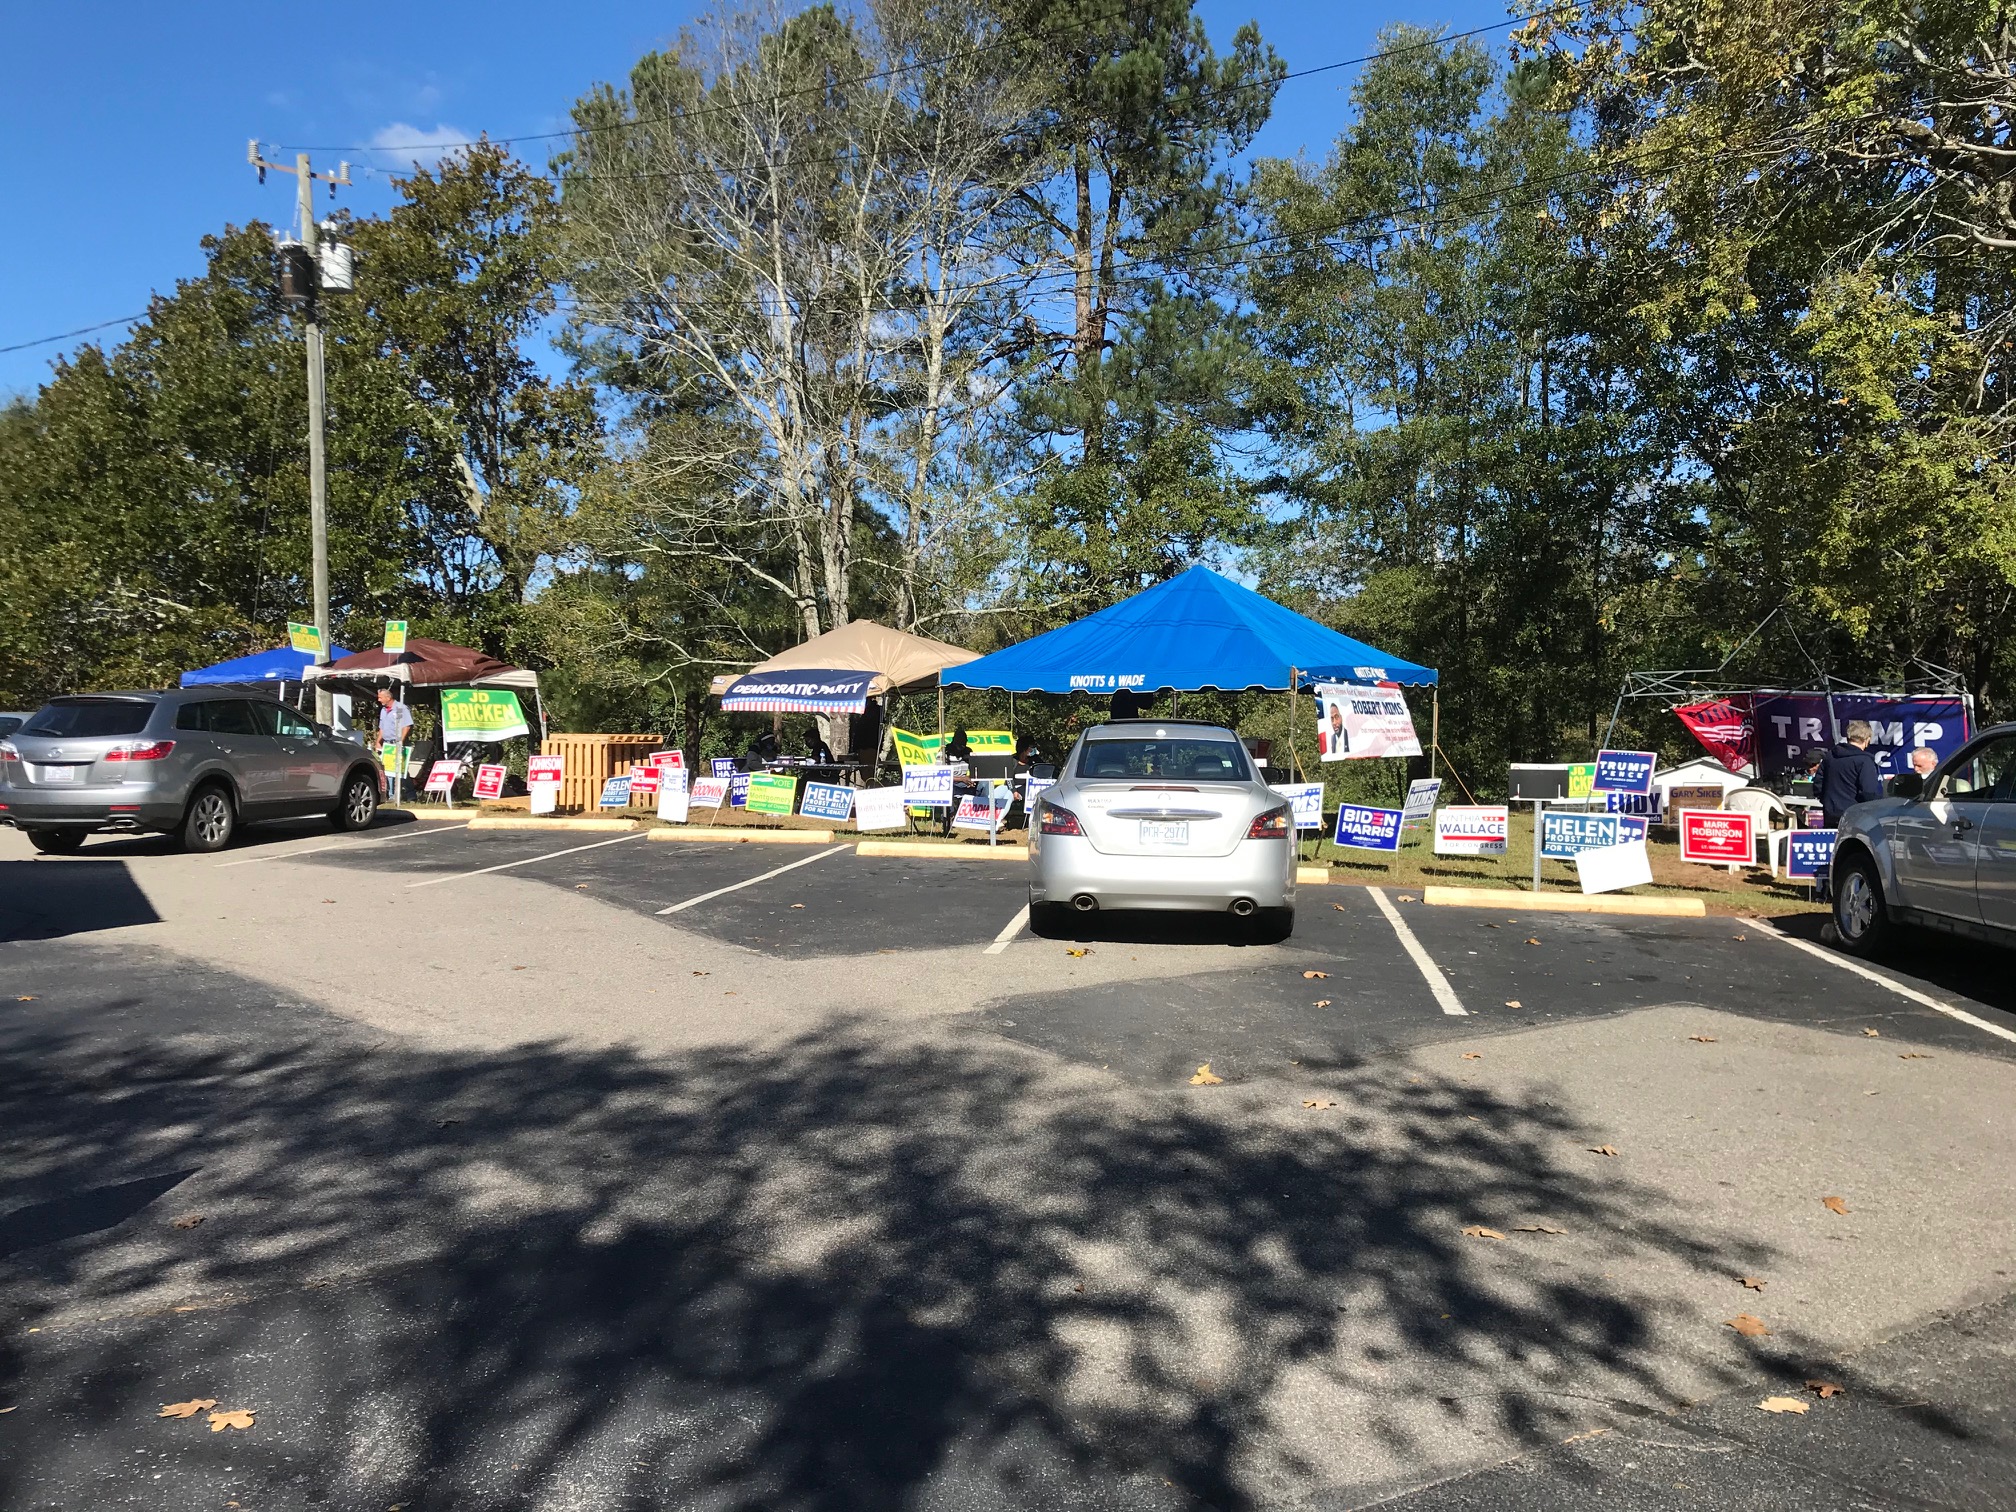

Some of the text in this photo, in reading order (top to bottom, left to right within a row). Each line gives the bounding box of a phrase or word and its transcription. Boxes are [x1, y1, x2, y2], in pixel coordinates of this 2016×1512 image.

[1070, 674, 1146, 687] KNOTTS & WADE
[732, 682, 864, 697] DEMOCRATIC PARTY
[469, 692, 490, 703] JD
[447, 702, 517, 722] BRICKEN
[1351, 700, 1404, 715] ROBERT MIMS
[531, 758, 562, 770] JOHNSON
[1599, 761, 1650, 772] TRUMP
[1570, 766, 1586, 776] JD
[1602, 771, 1643, 779] PENCE
[606, 780, 631, 791] HELEN
[773, 779, 792, 788] VOTE
[905, 776, 951, 793] MIMS
[750, 792, 792, 804] Montgomery
[807, 787, 852, 804] HELEN
[1405, 789, 1437, 808] MIMS
[806, 799, 830, 807] PROBST
[826, 808, 846, 816] SENATE
[1343, 808, 1398, 827] BIDEN
[1438, 814, 1481, 822] CYNTHIA
[1341, 822, 1394, 838] HARRIS
[1439, 823, 1505, 834] WALLACE
[1545, 818, 1615, 838] HELEN
[1703, 821, 1730, 829] MARK
[1691, 828, 1743, 839] ROBINSON
[1545, 833, 1614, 846] PROBST MILLS
[1545, 844, 1563, 852] FOR
[1565, 845, 1578, 853] NC
